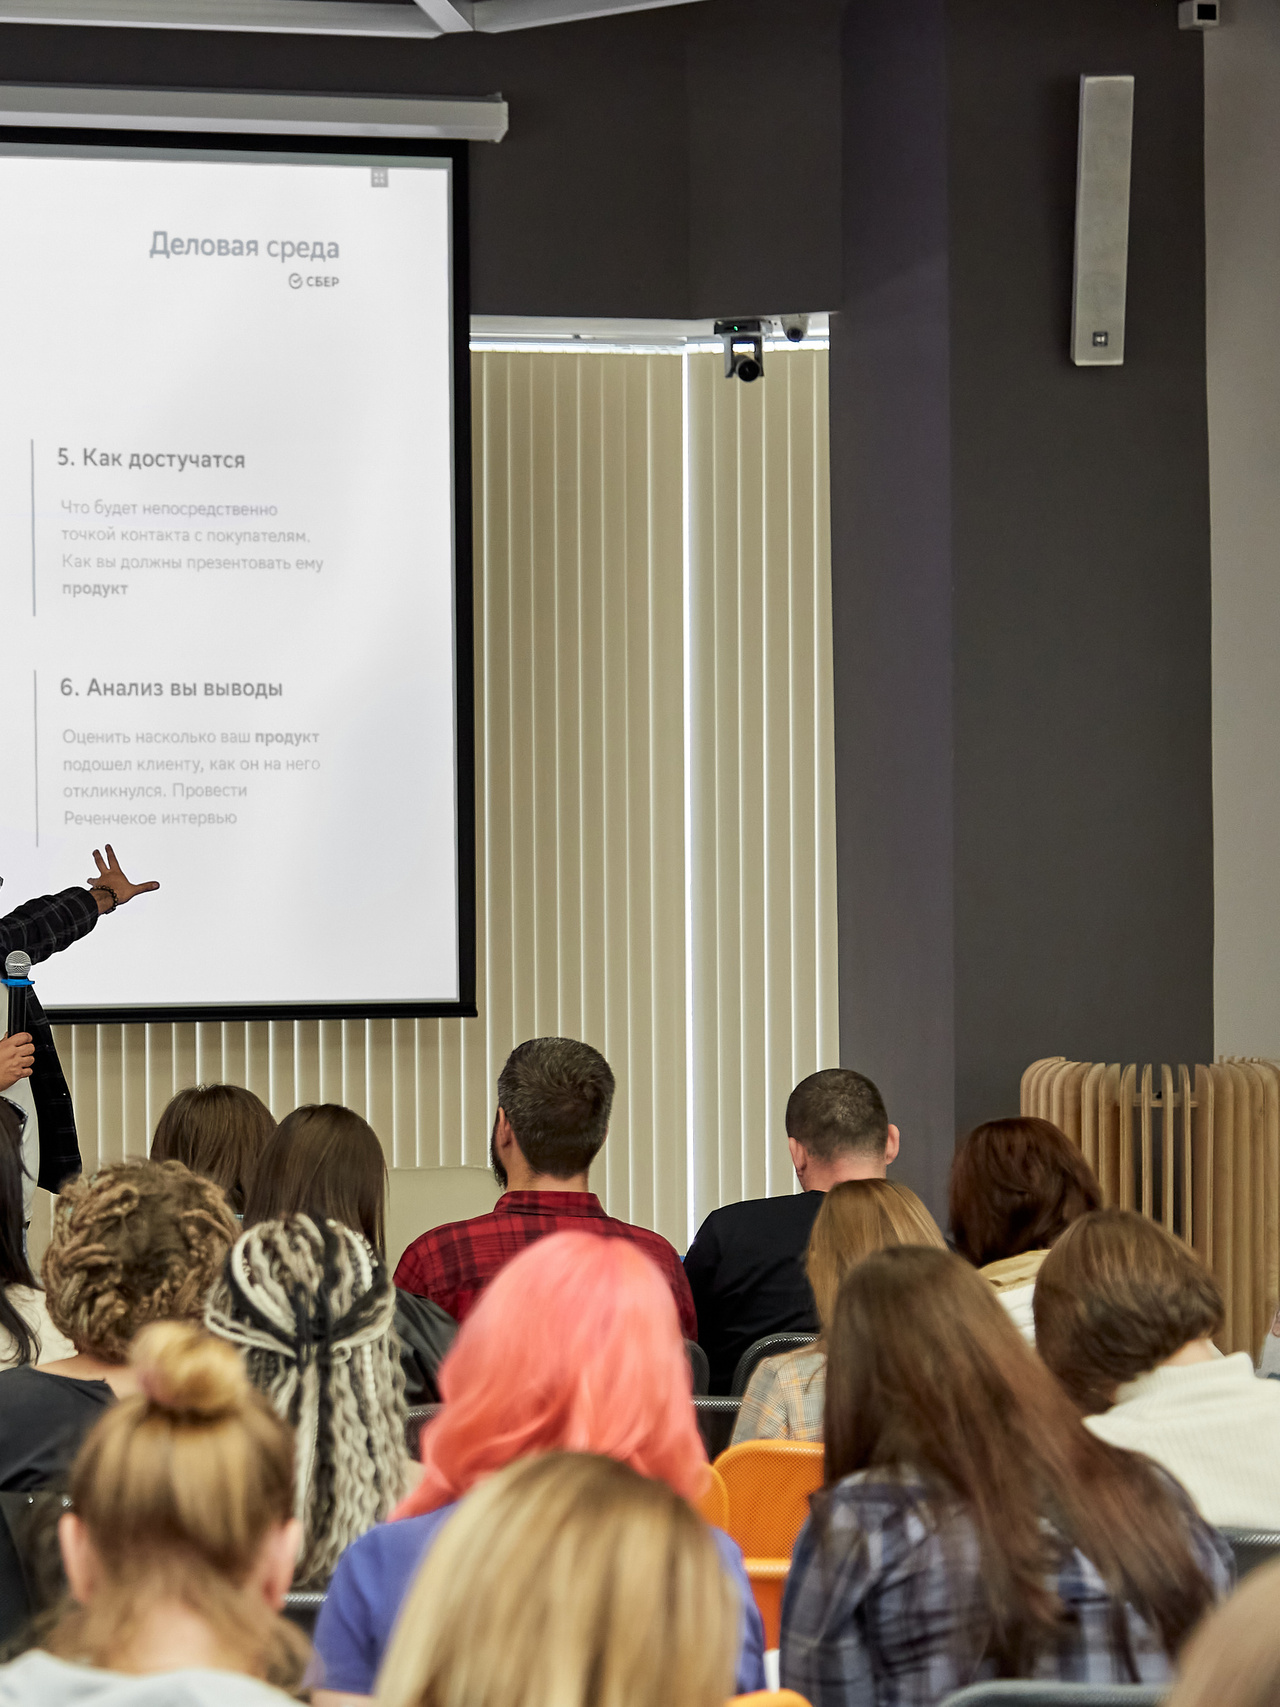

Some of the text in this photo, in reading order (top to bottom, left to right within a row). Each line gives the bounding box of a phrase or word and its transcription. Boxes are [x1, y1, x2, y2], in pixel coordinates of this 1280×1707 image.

[148, 230, 340, 263] Деловая среда
[305, 275, 340, 287] СБЕР
[57, 446, 246, 472] 5. Как достучатся
[60, 498, 279, 518] Что будет непосредственно
[60, 525, 311, 546] точкой контакта с покупателям.
[61, 553, 324, 573] Как вы должны презентовать ему
[62, 583, 129, 598] продукт
[59, 677, 283, 699] 6. Анализ вы выводы
[61, 728, 320, 747] Оценить насколько ваш продукт
[62, 758, 322, 774] подошел клиенту, как он на него
[62, 781, 248, 801] откликнулся. Провести
[63, 809, 238, 827] Реченчекое интервью
